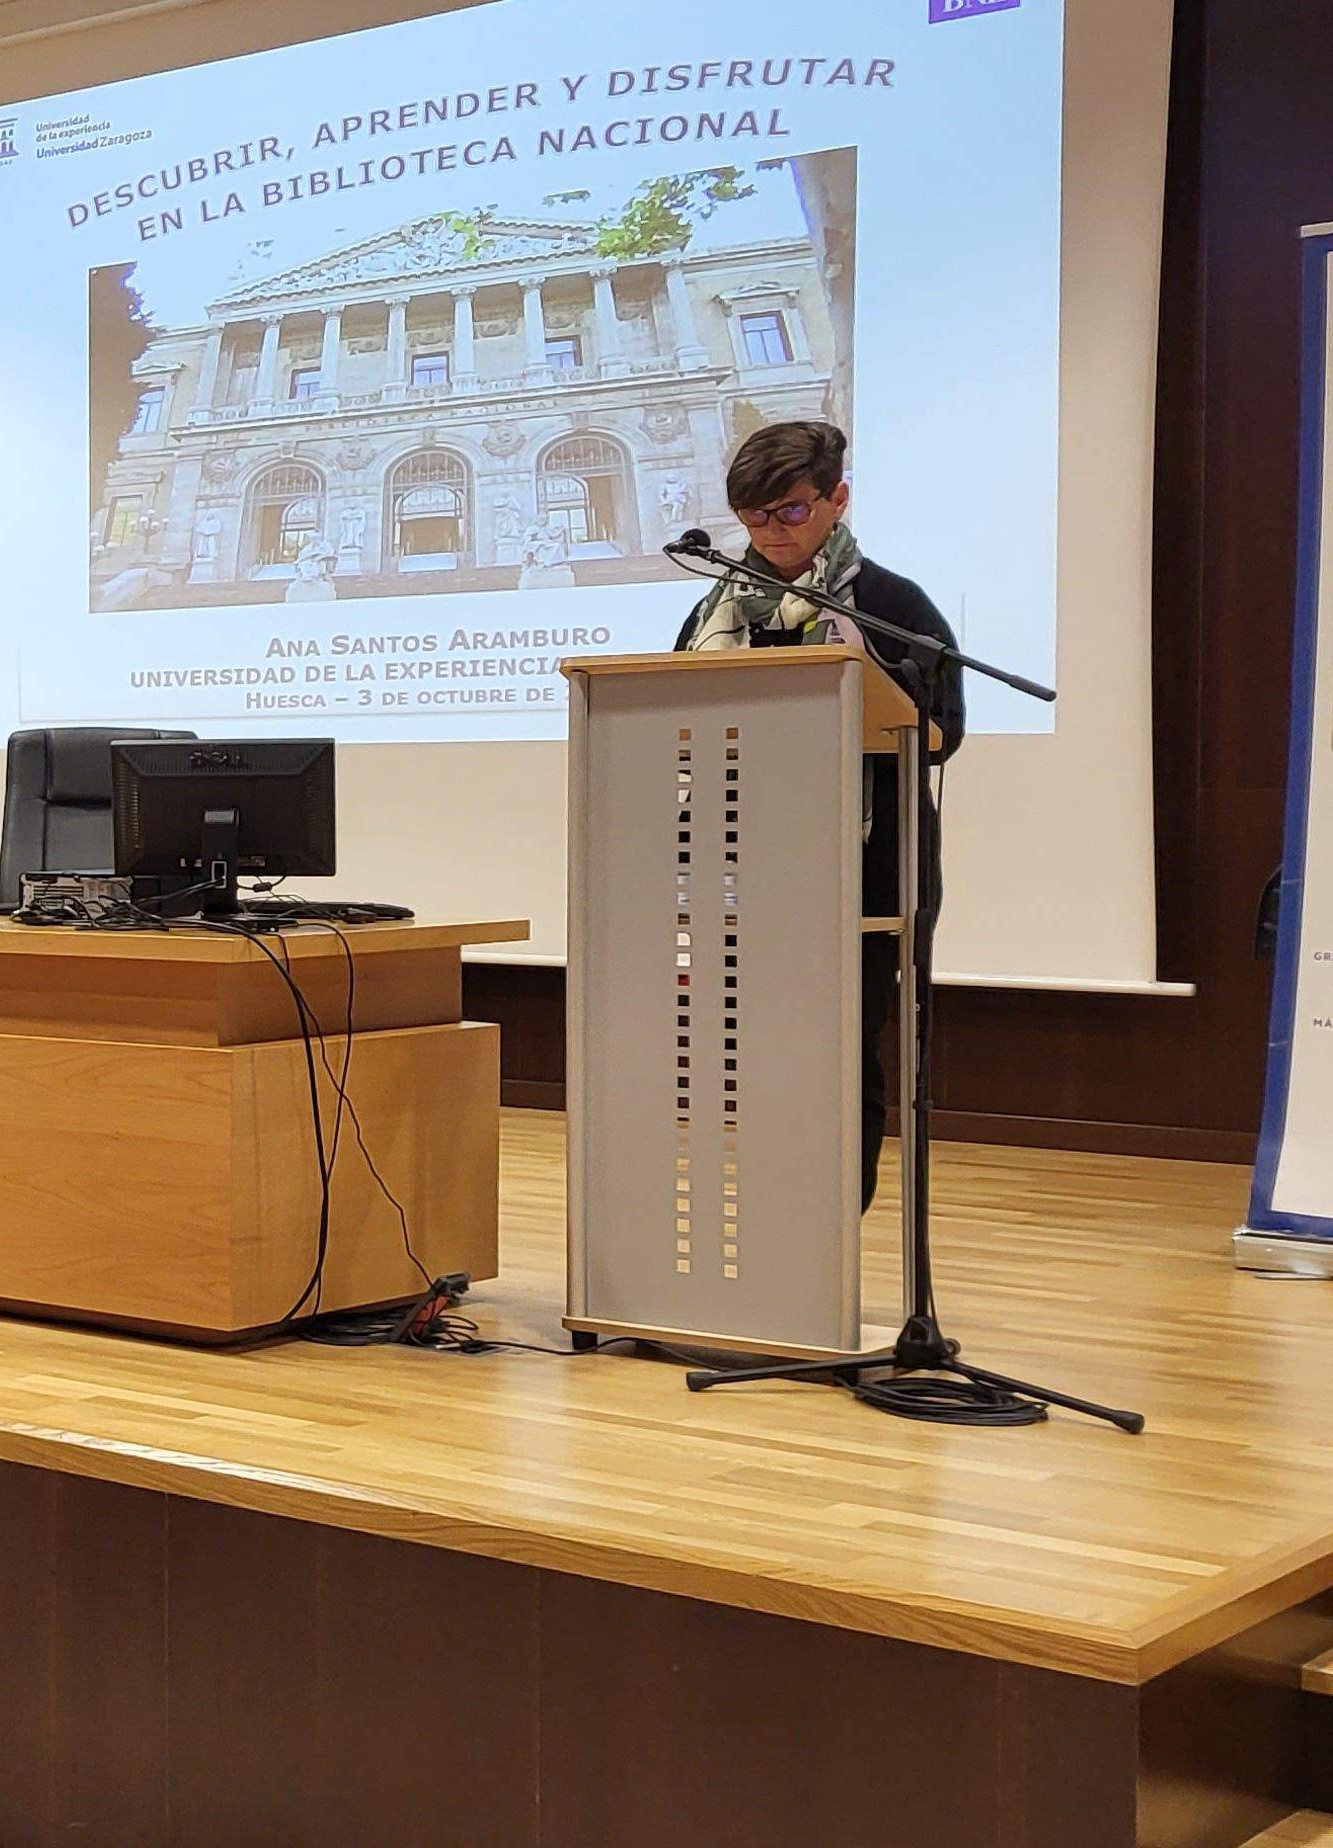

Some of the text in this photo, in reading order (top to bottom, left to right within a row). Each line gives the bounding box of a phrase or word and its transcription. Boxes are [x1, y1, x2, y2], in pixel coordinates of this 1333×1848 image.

[35, 113, 90, 132] Universidad
[35, 121, 111, 143] de la experiencia
[36, 128, 152, 159] Universidad Zaragoza
[67, 58, 896, 228] DESCUBRIR, APRENDER Y DISFRUTAR
[137, 108, 790, 241] EN LA BIBLIOTECA NACIONAL
[265, 626, 610, 658] ANA SANTOS ARAMBURO
[130, 667, 296, 688] UNIVERSIDAD
[305, 665, 337, 683] DE
[345, 663, 375, 681] LA
[246, 692, 326, 709] HUESCA
[358, 689, 372, 706] 3
[382, 691, 409, 706] DE
[417, 688, 517, 704] OCTUBRE
[526, 687, 555, 702] DE
